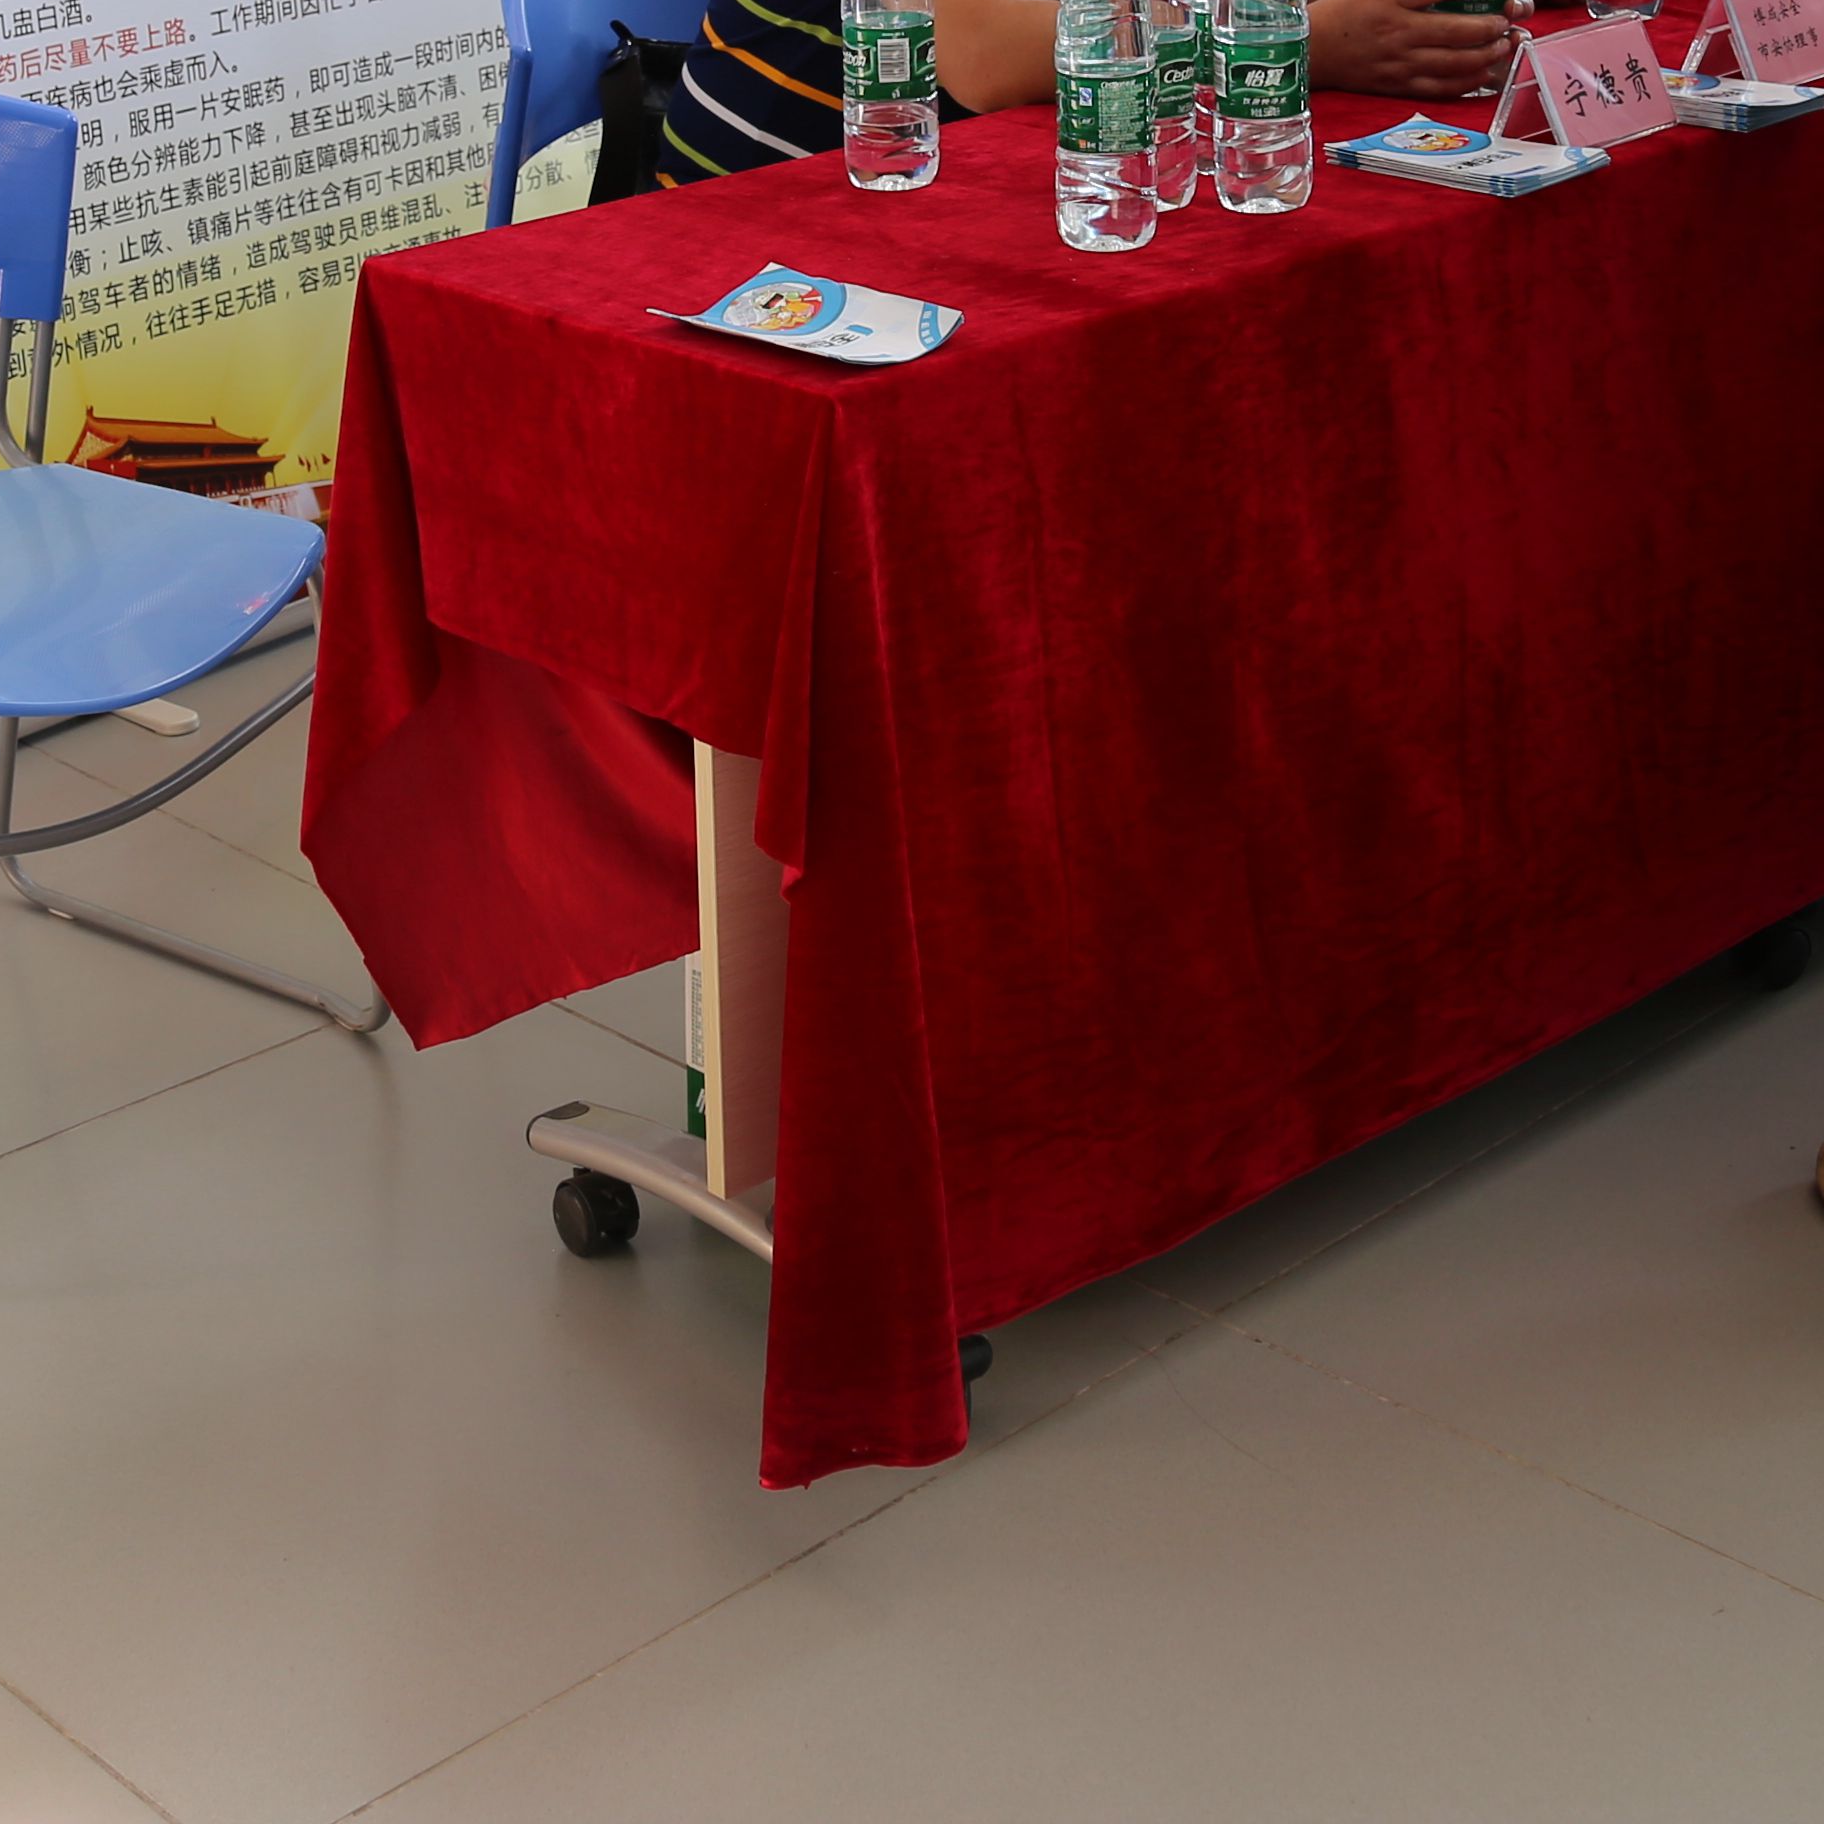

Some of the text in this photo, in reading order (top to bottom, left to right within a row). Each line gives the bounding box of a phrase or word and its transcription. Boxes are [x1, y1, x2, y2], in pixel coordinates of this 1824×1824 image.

[76, 23, 510, 153] 明，服用一片安眠药，即可造成一段时间内的
[69, 101, 506, 236] 用某些抗生素能引起前庭障碍和视力减弱，有
